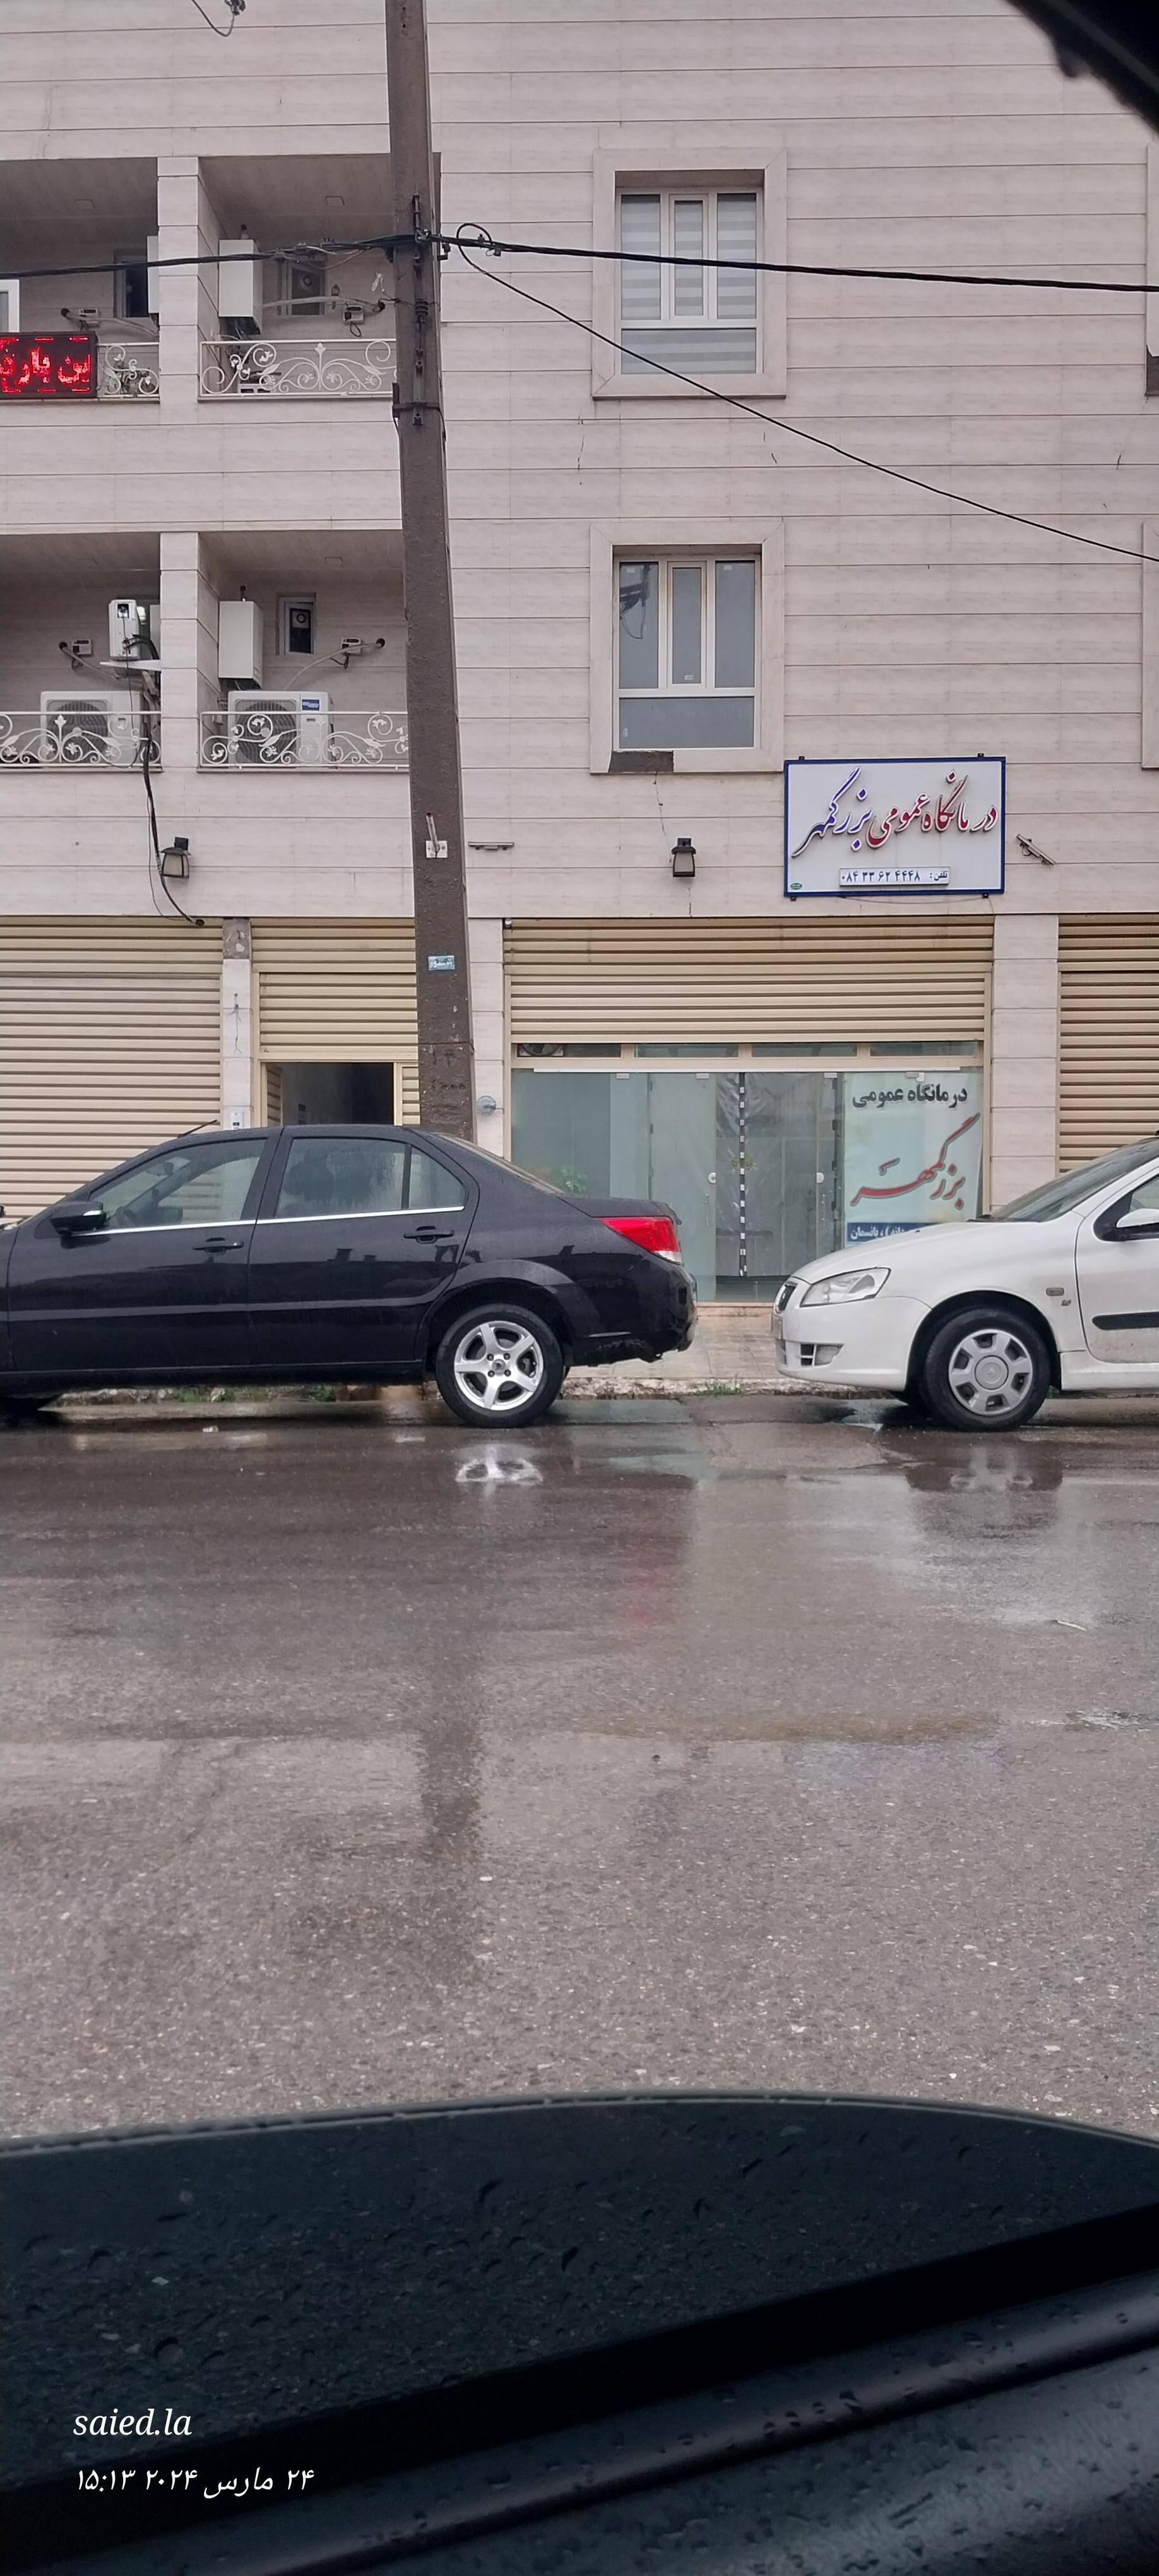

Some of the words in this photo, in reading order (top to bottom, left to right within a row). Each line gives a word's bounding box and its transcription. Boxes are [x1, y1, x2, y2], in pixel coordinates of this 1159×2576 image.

[792, 766, 873, 857] بزرگمهر
[867, 793, 930, 847] عمومی
[841, 871, 858, 881] ۰۸۴
[862, 871, 874, 881] ۳۳
[878, 871, 890, 881] ۶۲
[895, 870, 920, 881] ۴۴۴۸
[852, 1088, 903, 1108] عمومی
